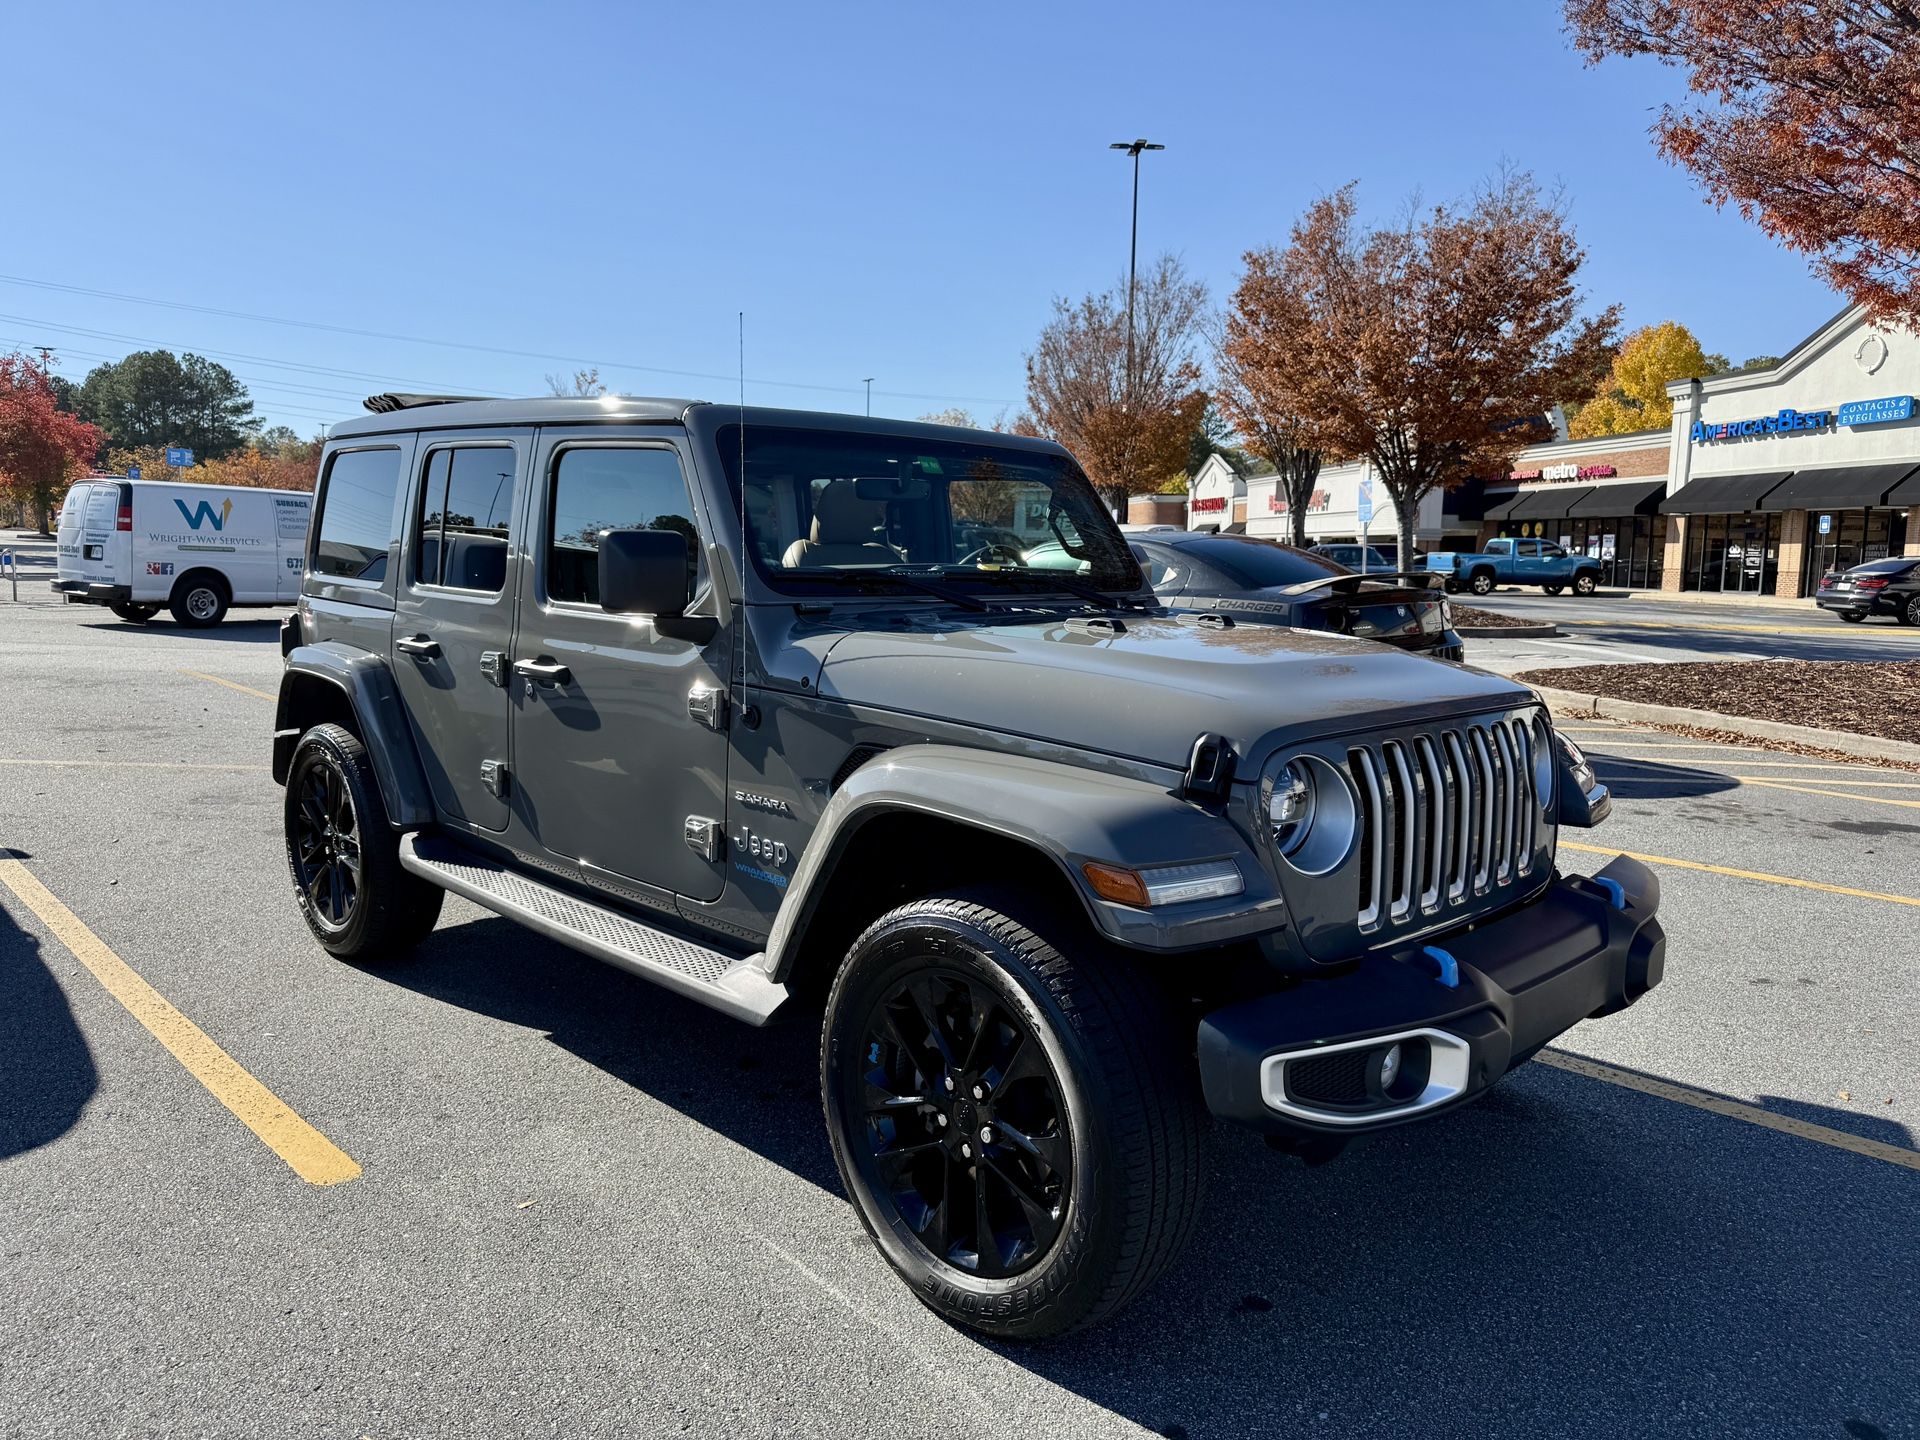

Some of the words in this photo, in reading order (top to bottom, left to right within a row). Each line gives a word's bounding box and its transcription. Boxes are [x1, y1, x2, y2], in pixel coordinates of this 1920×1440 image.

[1842, 400, 1896, 414] CONTACTS
[1778, 409, 1831, 432] BEST
[1842, 408, 1905, 424] EYEGLASSES
[1542, 462, 1578, 480] metro
[149, 532, 217, 544] WRIGHT-WAY
[219, 535, 261, 546] SERVICES
[1218, 600, 1283, 614] CHARGER
[734, 790, 789, 812] SAHARA
[733, 826, 788, 867] Jeep
